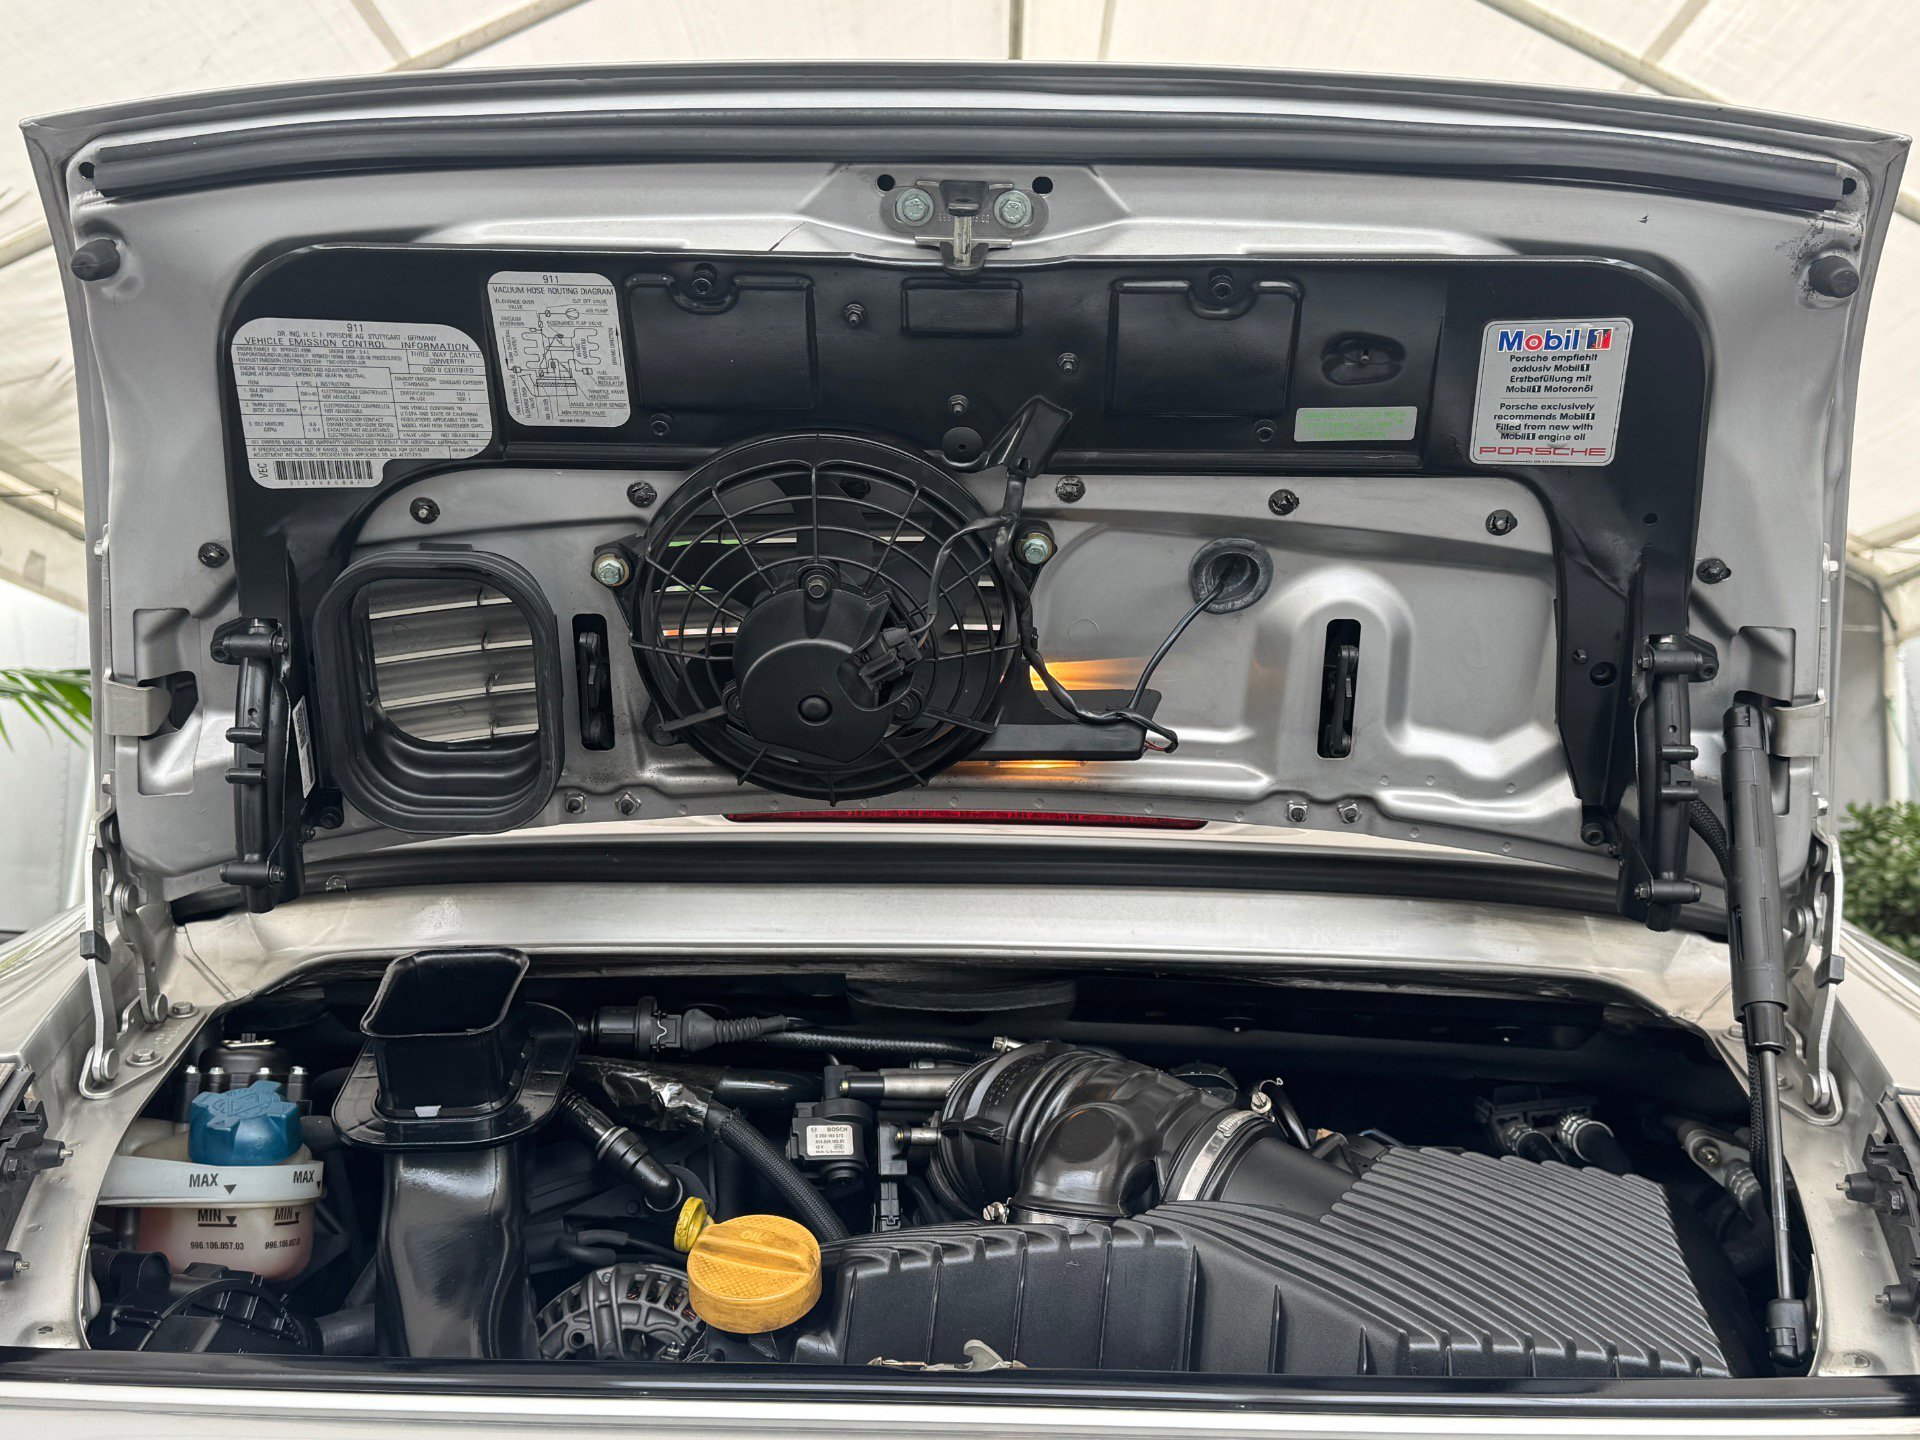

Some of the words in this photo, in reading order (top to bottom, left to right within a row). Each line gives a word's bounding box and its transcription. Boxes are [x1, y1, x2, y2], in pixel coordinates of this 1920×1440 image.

[543, 275, 559, 283] 911
[493, 286, 524, 294] VACUUM
[347, 324, 363, 332] 911
[244, 337, 284, 345] VEHICLE
[342, 340, 384, 348] CONTROL
[401, 342, 469, 350] INFORMATION
[1497, 328, 1581, 352] Mobil
[1551, 354, 1598, 362] empfiehlt
[1510, 375, 1573, 383] Erstbefüllung
[1541, 403, 1595, 411] exclusively
[1538, 434, 1571, 442] engine
[1479, 446, 1606, 456] PORSCHE
[257, 463, 268, 478] VEC
[189, 1174, 219, 1188] MAX
[293, 1170, 315, 1184] MAX
[198, 1208, 222, 1222] MIN
[274, 1207, 293, 1220] MIN
[190, 1242, 244, 1250] 996.106.057.03
